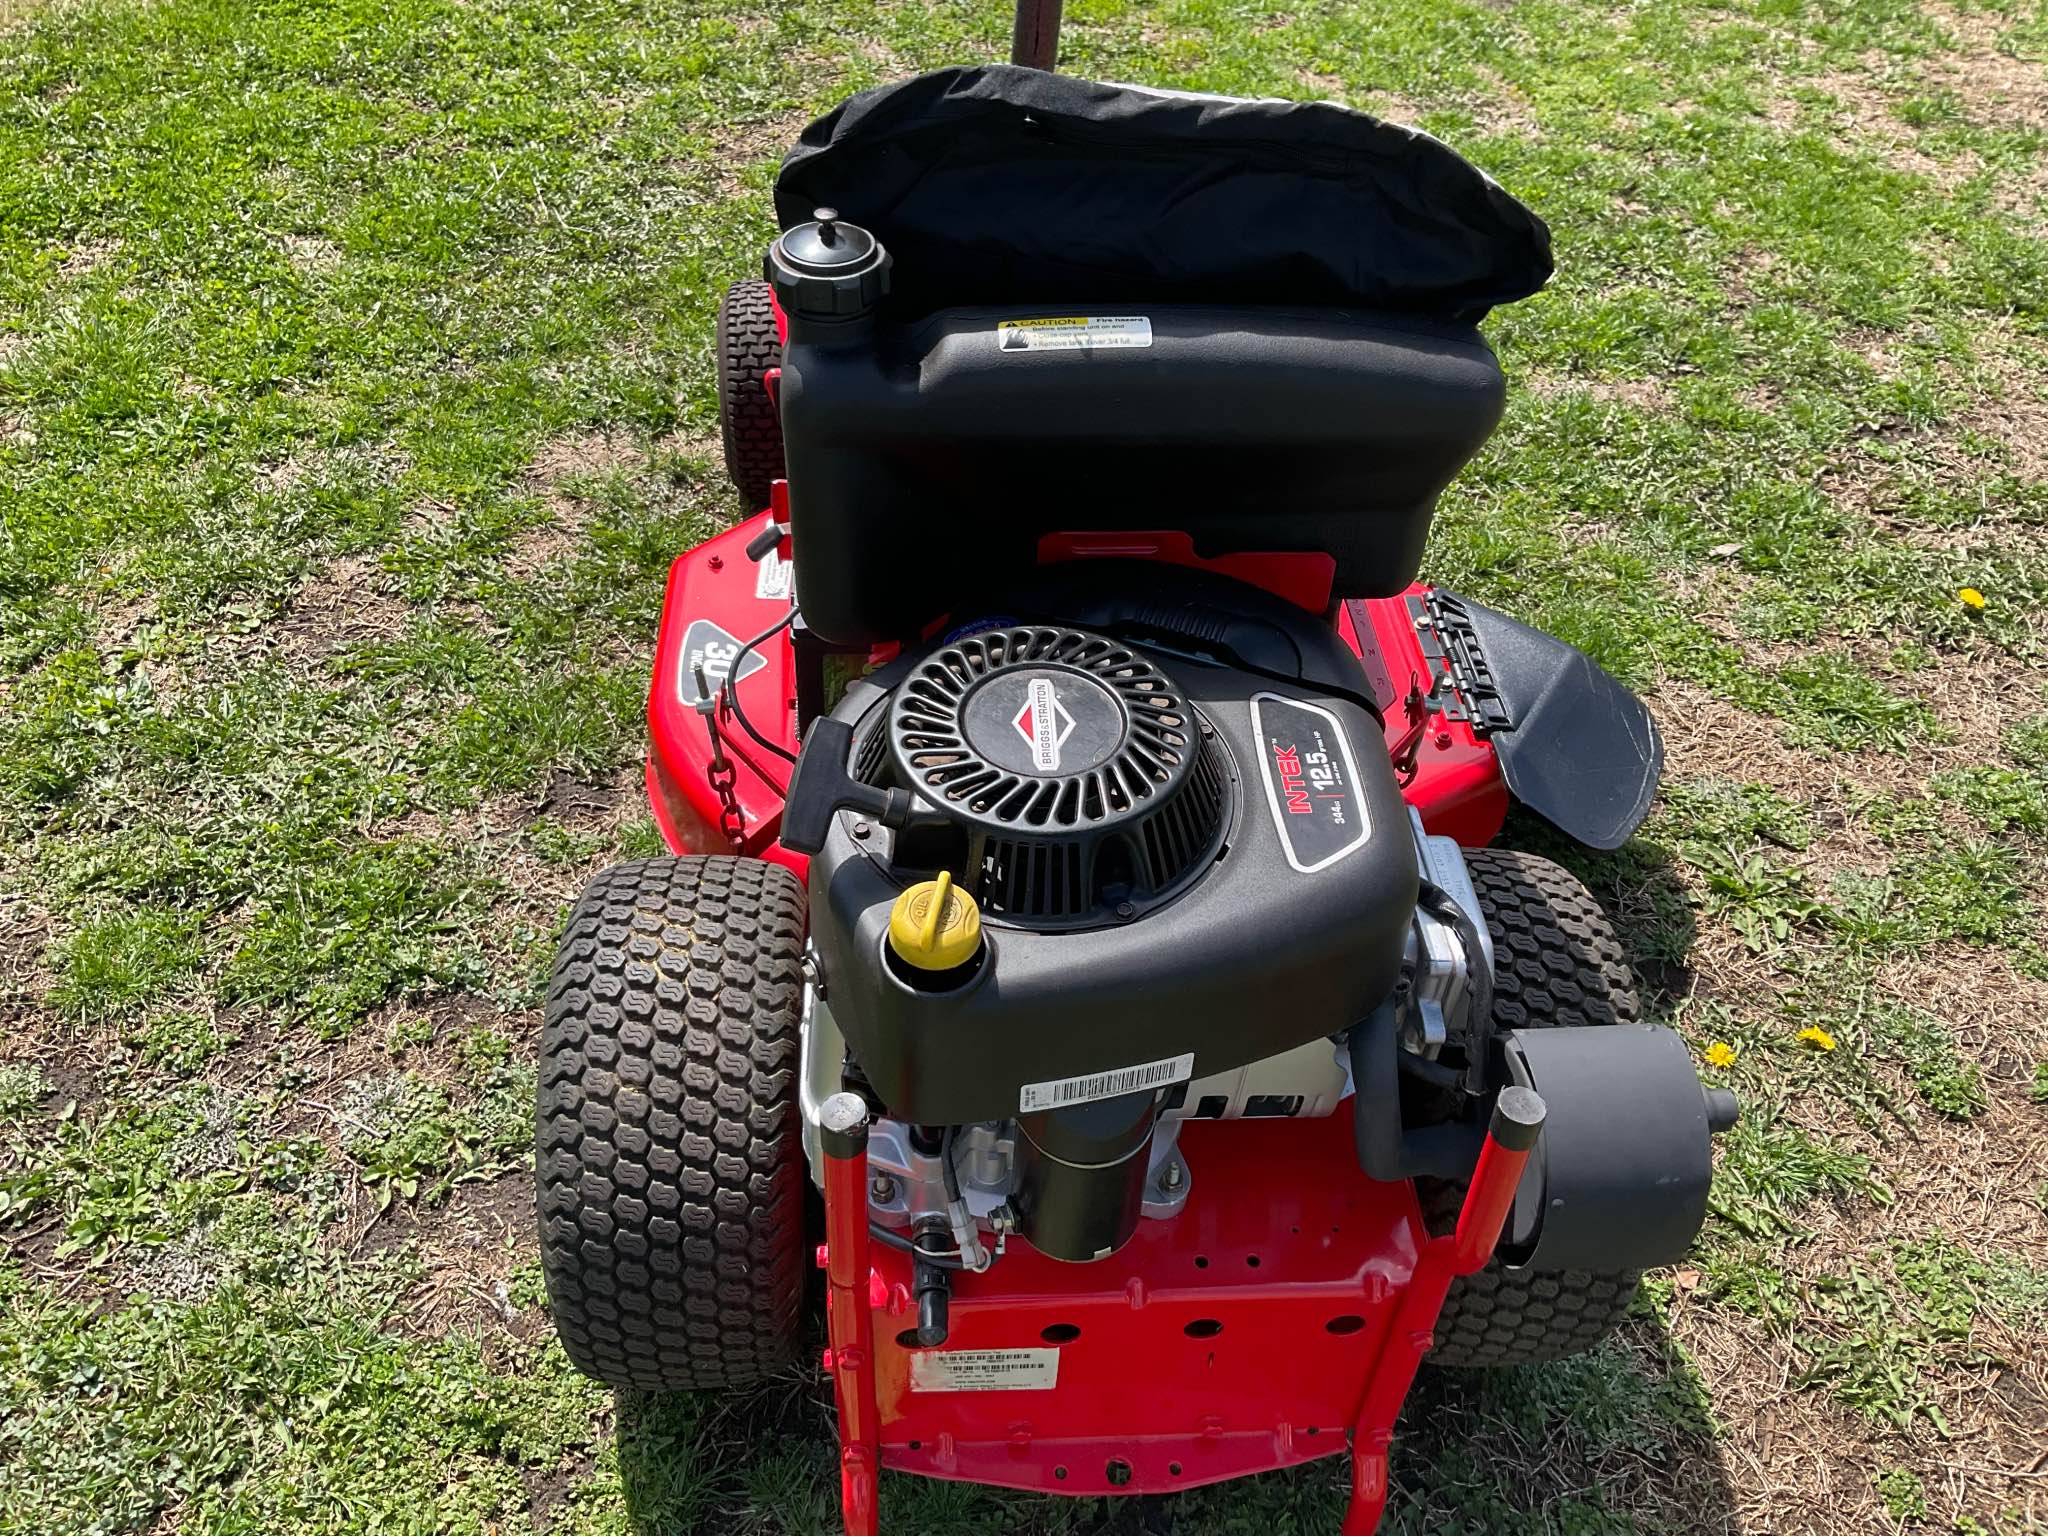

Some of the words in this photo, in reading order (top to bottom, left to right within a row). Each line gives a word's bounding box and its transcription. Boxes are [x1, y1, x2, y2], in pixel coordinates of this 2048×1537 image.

[1020, 319, 1077, 327] CAUTION
[703, 642, 738, 678] 30
[1273, 743, 1313, 814] INTEK
[1305, 752, 1334, 791] 12.5
